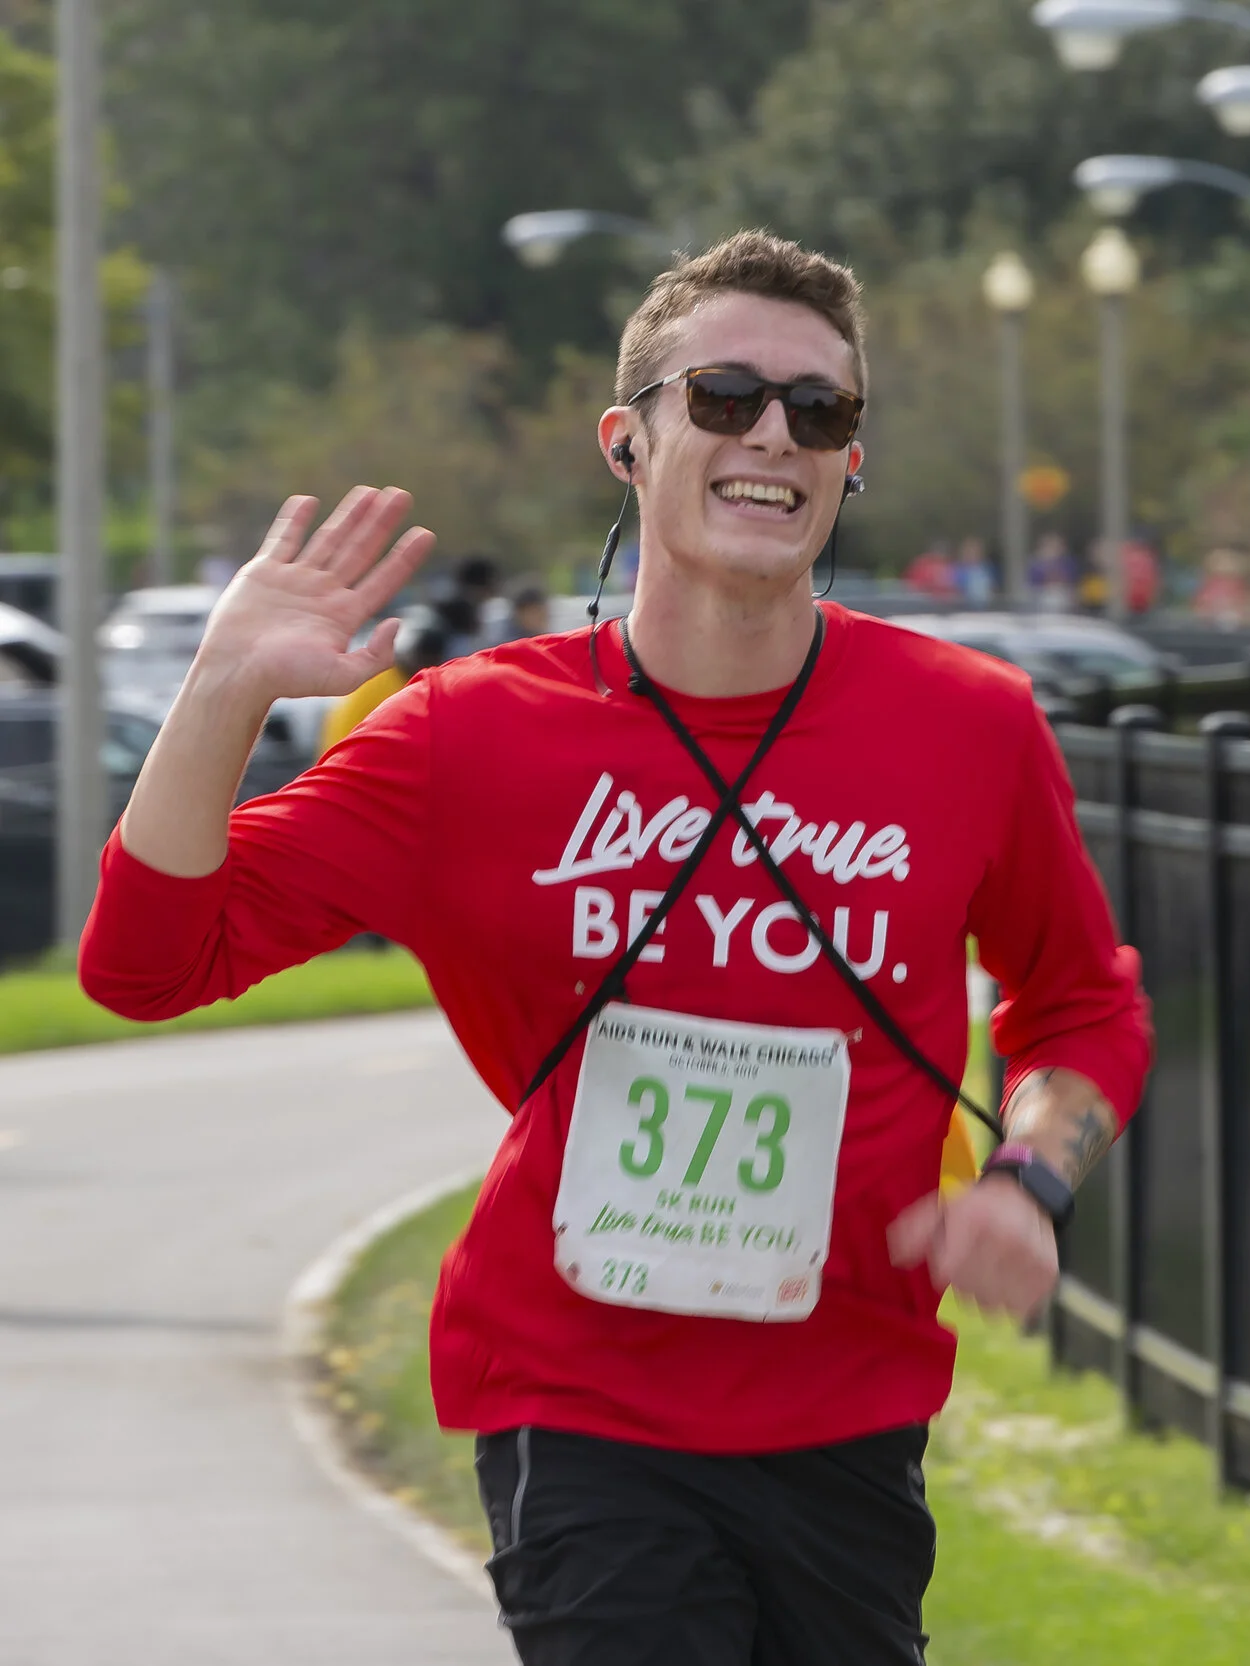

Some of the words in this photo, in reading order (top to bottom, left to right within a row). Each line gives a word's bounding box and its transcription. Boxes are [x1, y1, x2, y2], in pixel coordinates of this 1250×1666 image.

[532, 771, 712, 886] Live
[572, 886, 668, 963] BE
[695, 894, 908, 984] YOU.
[598, 1020, 636, 1044] AIDS
[640, 1027, 679, 1049] RUN
[682, 1033, 695, 1053] &
[699, 1036, 751, 1063] WALK
[756, 1045, 834, 1070] CHICAGO
[617, 1073, 793, 1196] 373
[687, 1192, 737, 1217] RUN
[699, 1219, 732, 1248] BE
[600, 1257, 650, 1297] 373
